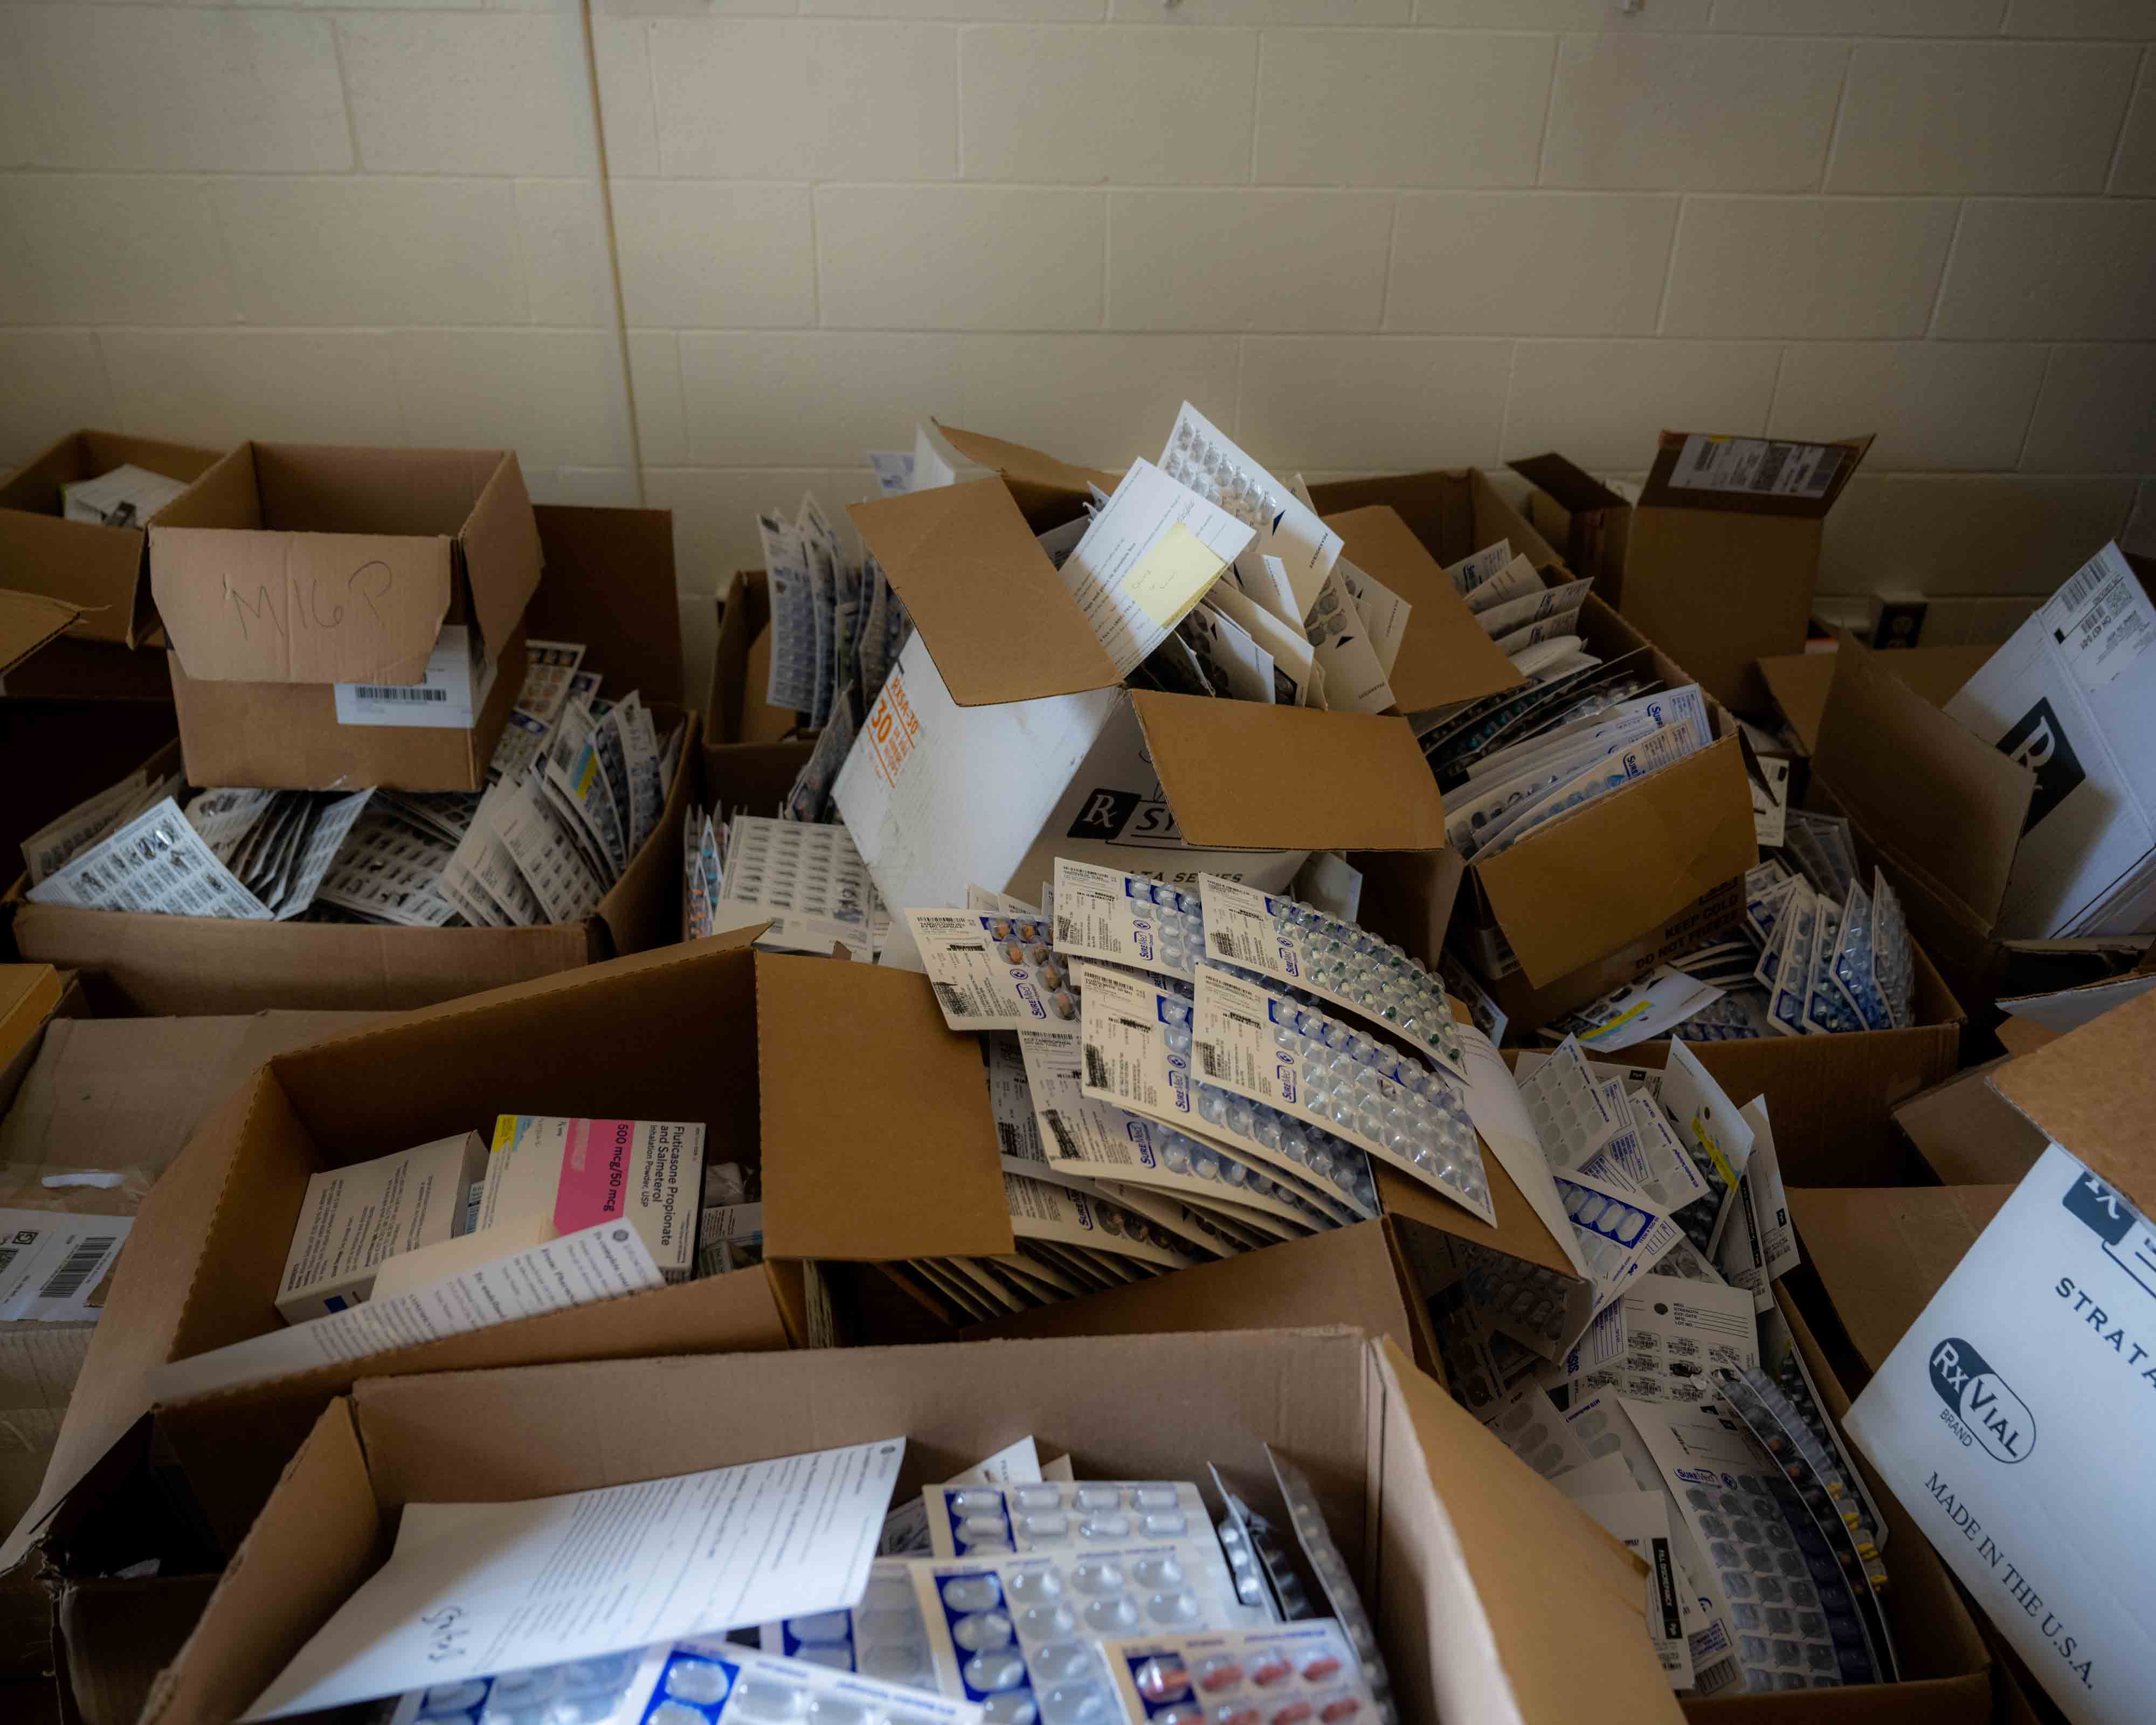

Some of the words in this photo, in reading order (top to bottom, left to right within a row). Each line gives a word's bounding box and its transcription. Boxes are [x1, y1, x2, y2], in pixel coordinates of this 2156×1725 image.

[871, 698, 892, 742] 30
[1703, 895, 1738, 919] COLD
[1635, 953, 1655, 969] DO
[1658, 935, 1686, 958] NOT
[616, 1123, 628, 1144] 500
[659, 1124, 669, 1145] and
[609, 1146, 624, 1188] mcg/50
[652, 1146, 669, 1202] Salmeterol
[668, 1126, 685, 1184] Fluticasone
[603, 1188, 617, 1212] mcg
[640, 1191, 649, 1208] USP
[661, 1185, 679, 1246] Propionate
[1940, 1408, 1973, 1448] BRAND
[1925, 1471, 1981, 1541] MADE
[1977, 1535, 2005, 1568] IN
[2001, 1563, 2043, 1617] THE
[2041, 1613, 2093, 1689] U.S.A.
